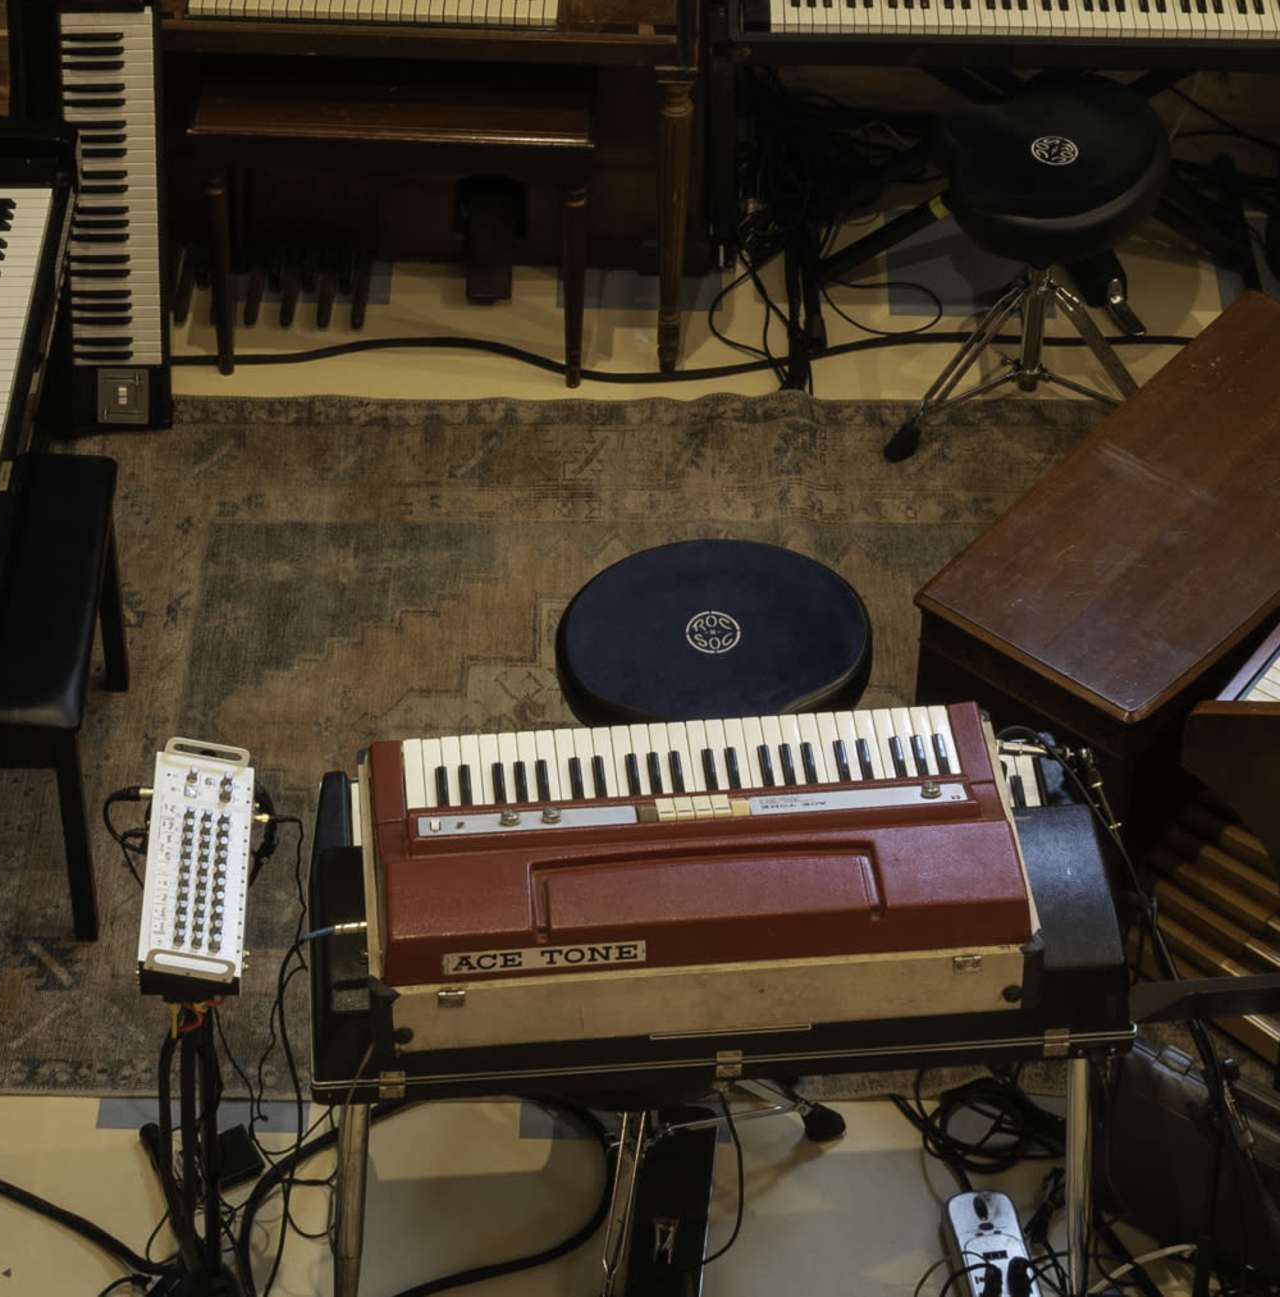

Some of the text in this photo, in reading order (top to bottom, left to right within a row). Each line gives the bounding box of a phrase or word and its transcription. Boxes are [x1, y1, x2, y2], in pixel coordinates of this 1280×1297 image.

[692, 615, 733, 632] ROC
[693, 632, 733, 650] SOC
[452, 944, 640, 972] ACE TONE
